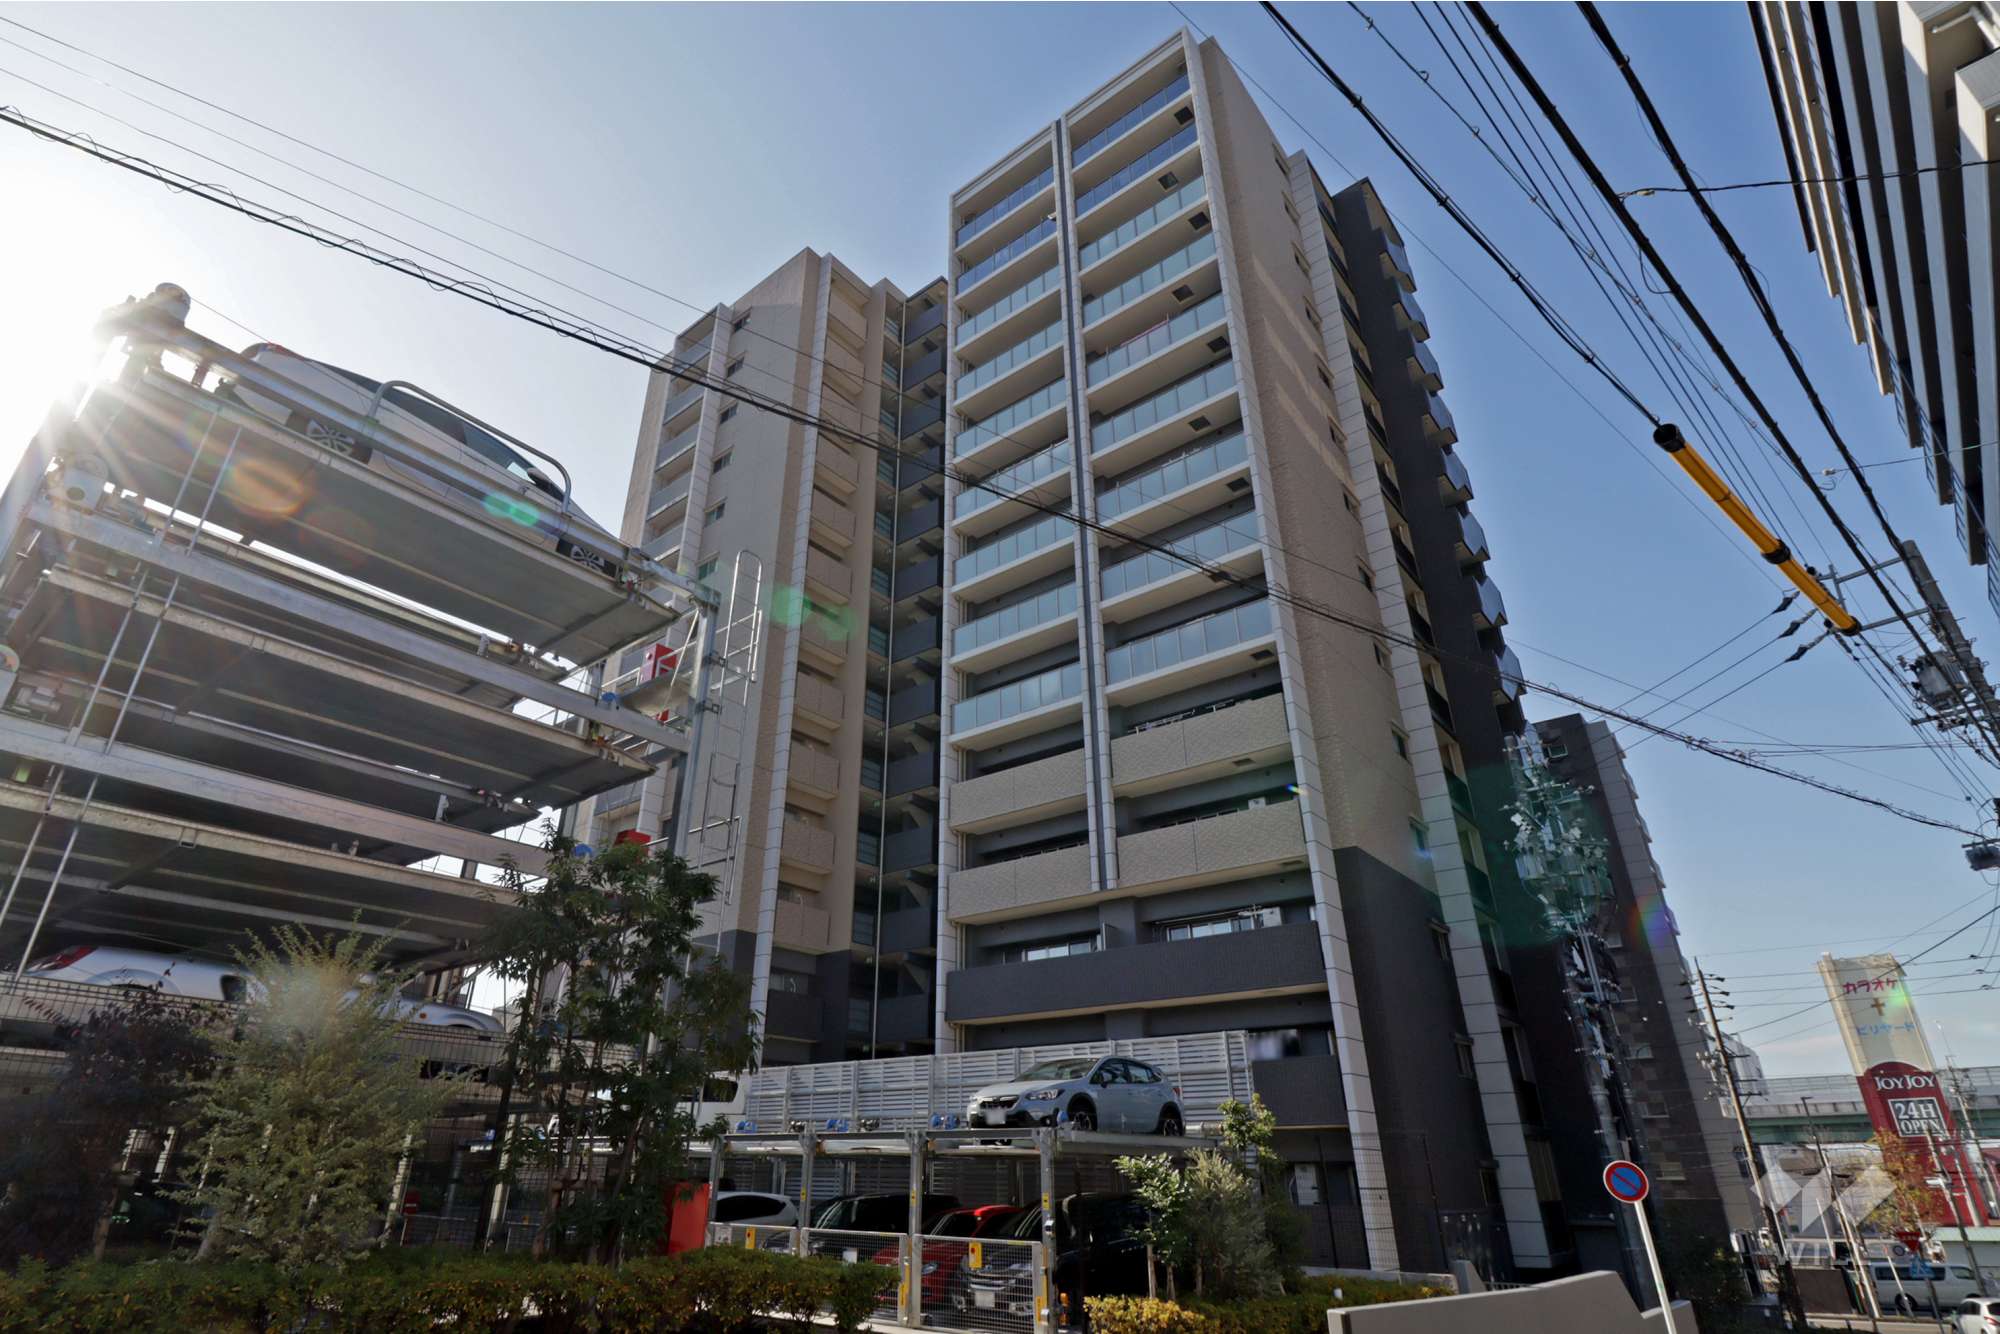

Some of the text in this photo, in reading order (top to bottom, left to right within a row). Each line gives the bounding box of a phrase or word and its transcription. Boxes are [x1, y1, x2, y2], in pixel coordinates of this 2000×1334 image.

[1842, 978, 1898, 994] カラオケ
[1895, 1102, 1937, 1119] 24H
[1901, 1119, 1944, 1134] OPEN
